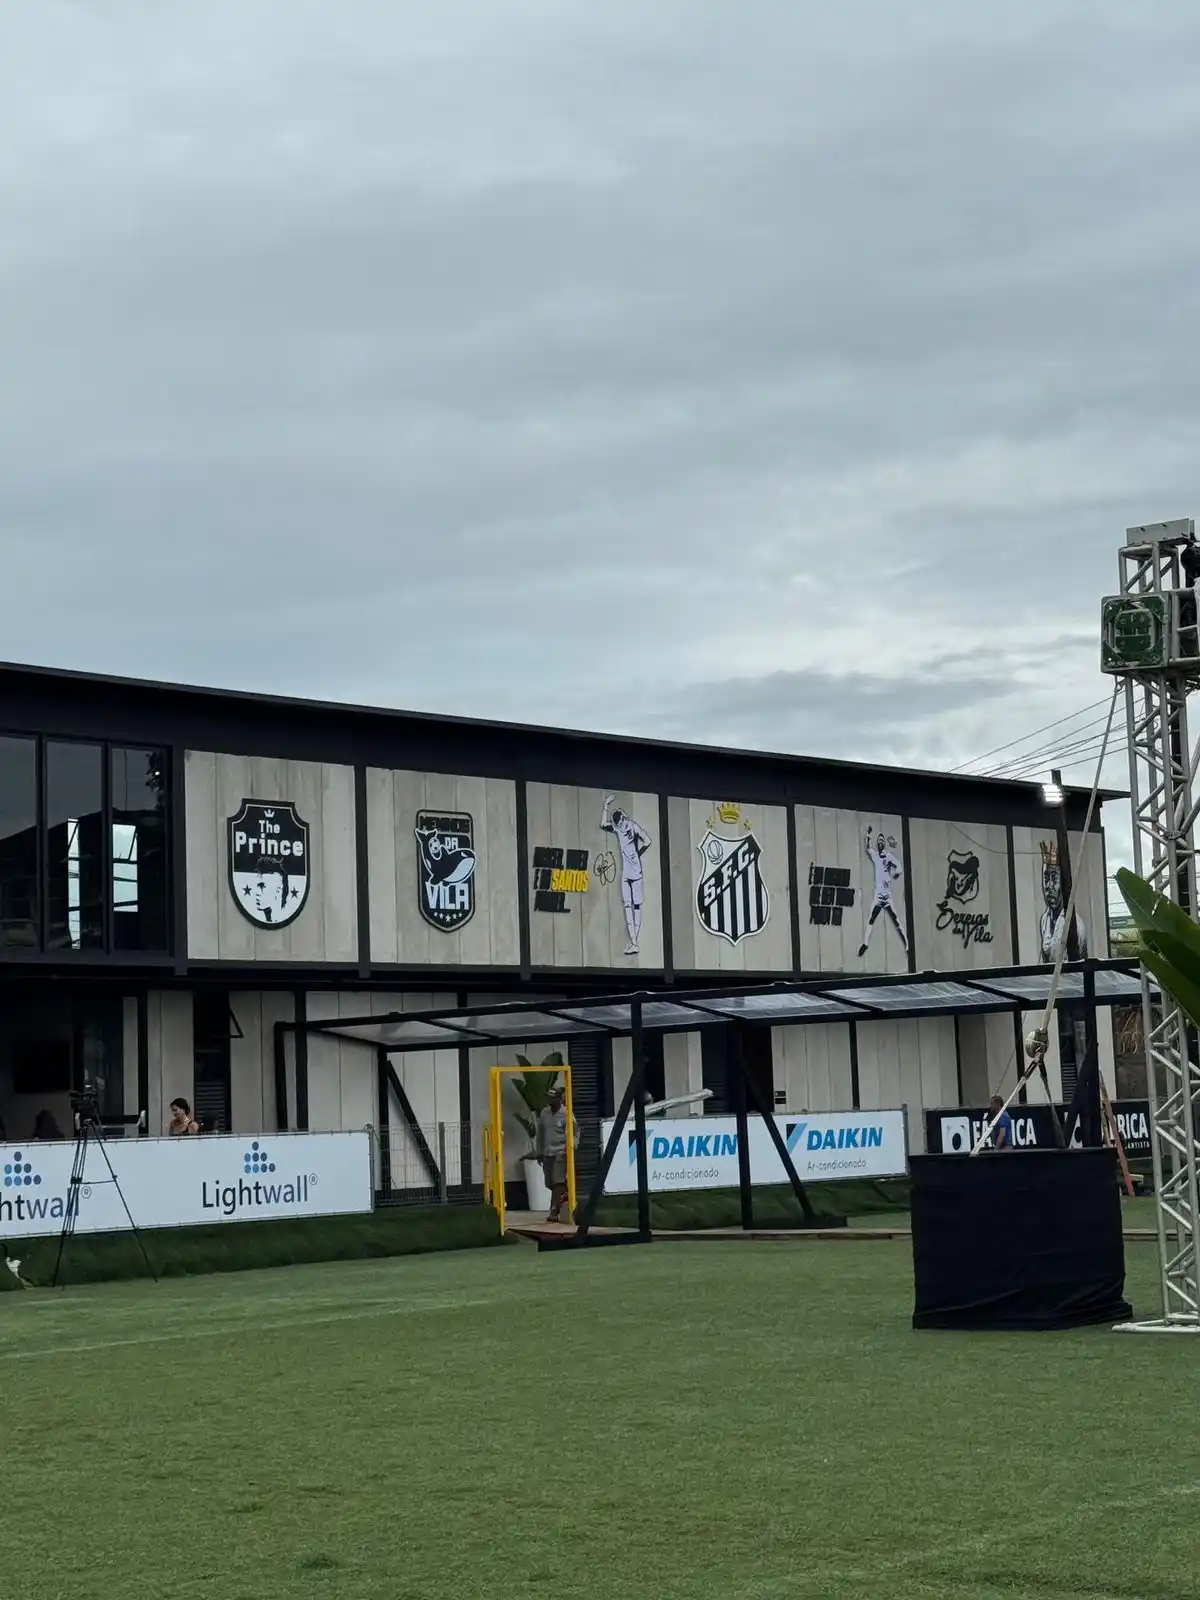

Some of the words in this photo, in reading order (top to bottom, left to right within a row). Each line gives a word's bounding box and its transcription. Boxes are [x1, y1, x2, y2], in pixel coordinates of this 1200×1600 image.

[259, 820, 280, 834] The
[235, 831, 304, 857] Prince
[551, 869, 589, 892] SANTOS
[703, 842, 755, 907] S.F.C.
[425, 880, 469, 910] VILA
[806, 1127, 883, 1151] DAIKIN
[972, 1112, 1038, 1149] FÁICA
[652, 1134, 737, 1159] DAIKIN
[807, 1158, 867, 1172] Ar-condicionado
[202, 1175, 308, 1215] Lightwall
